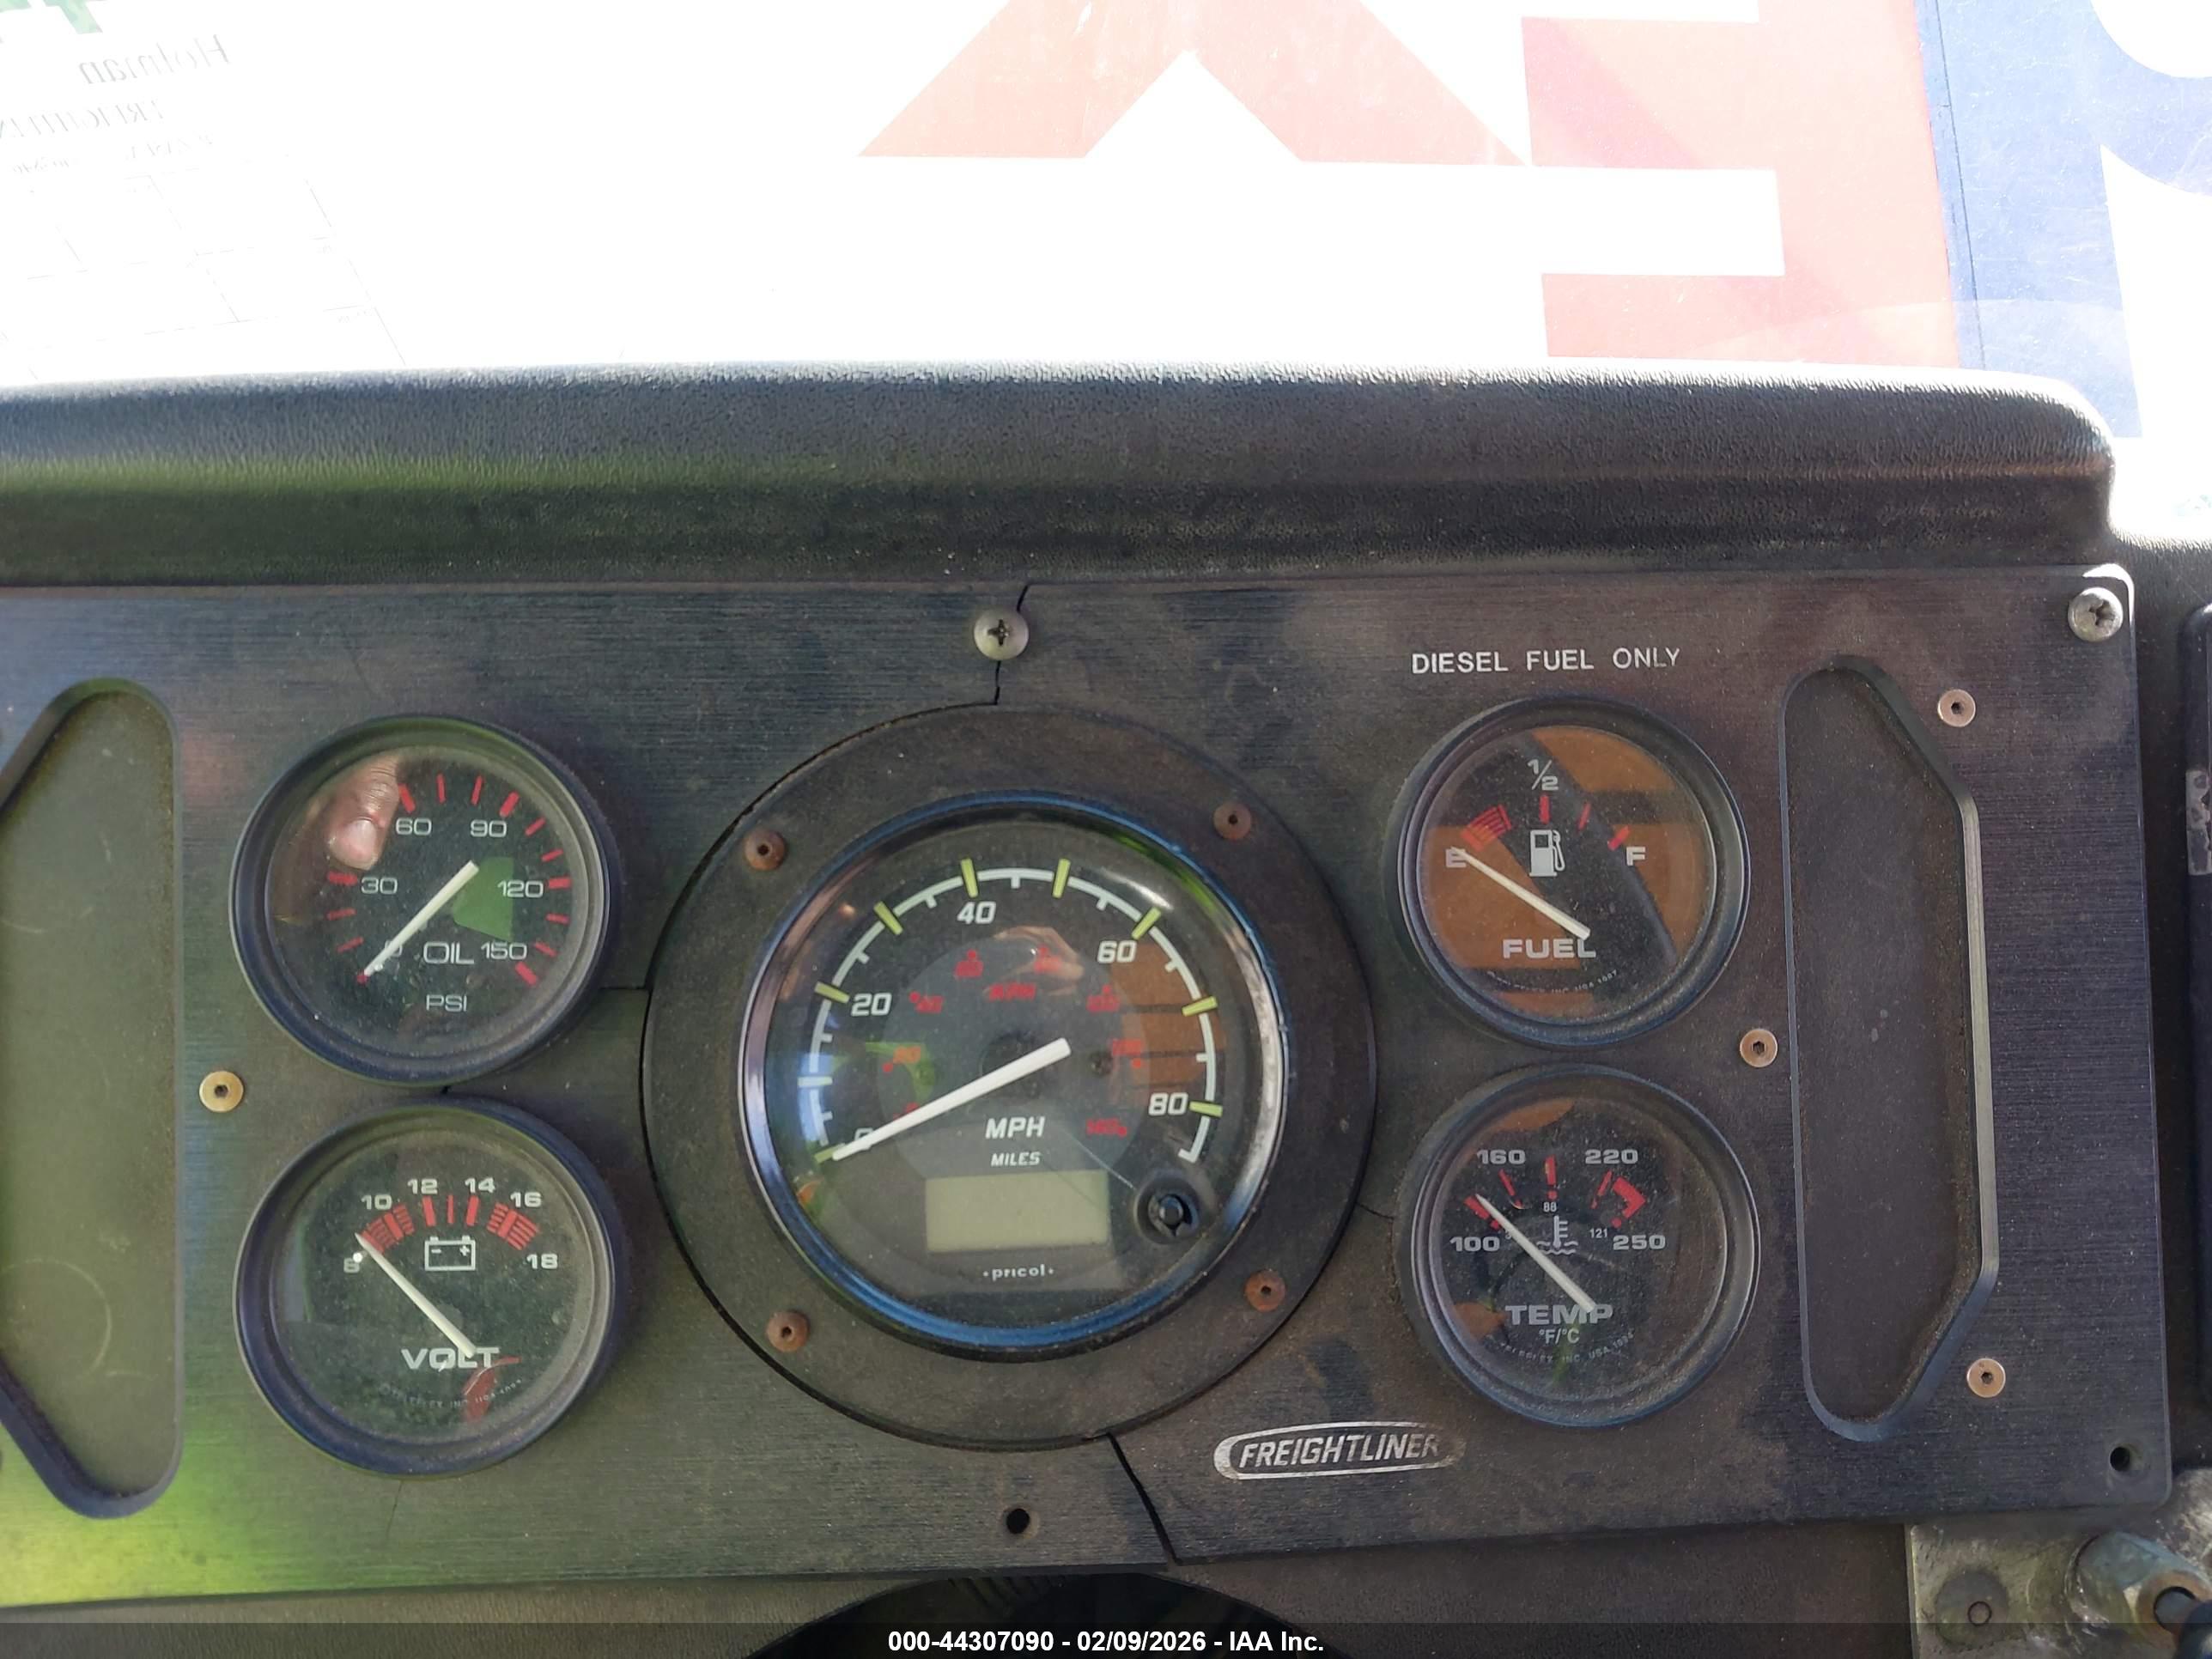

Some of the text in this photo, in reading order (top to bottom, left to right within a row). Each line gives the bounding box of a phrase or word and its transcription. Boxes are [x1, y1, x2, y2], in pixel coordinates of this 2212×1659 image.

[1412, 647, 1680, 674] DIESEL FUEL ONLY
[396, 818, 432, 836] 60
[471, 820, 507, 838] 90
[1445, 848, 1466, 867] E
[1626, 847, 1646, 866] F
[361, 878, 398, 895] 30
[497, 880, 544, 898] 120
[957, 902, 996, 925] 40
[423, 943, 474, 965] OIL
[481, 943, 527, 961] 150
[1097, 940, 1138, 963] 60
[1503, 939, 1596, 959] FUEL
[426, 995, 467, 1012] PSI
[851, 994, 891, 1017] 20
[1148, 1093, 1188, 1116] 80
[985, 1116, 1045, 1139] MPH
[991, 1152, 1041, 1167] MILES
[1477, 1149, 1526, 1164] 160
[1584, 1149, 1638, 1164] 220
[407, 1180, 439, 1194] 12
[465, 1178, 495, 1194] 14
[361, 1194, 392, 1210] 10
[510, 1192, 542, 1207] 16
[1589, 1228, 1608, 1239] 121
[1613, 1235, 1666, 1250] 250
[1449, 1237, 1500, 1252] 100
[526, 1254, 558, 1270] 18
[992, 1264, 1045, 1282] pricol
[1505, 1304, 1613, 1324] TEMP
[401, 1347, 501, 1370] VOLT
[1238, 1433, 1441, 1468] FREIGHTLINER
